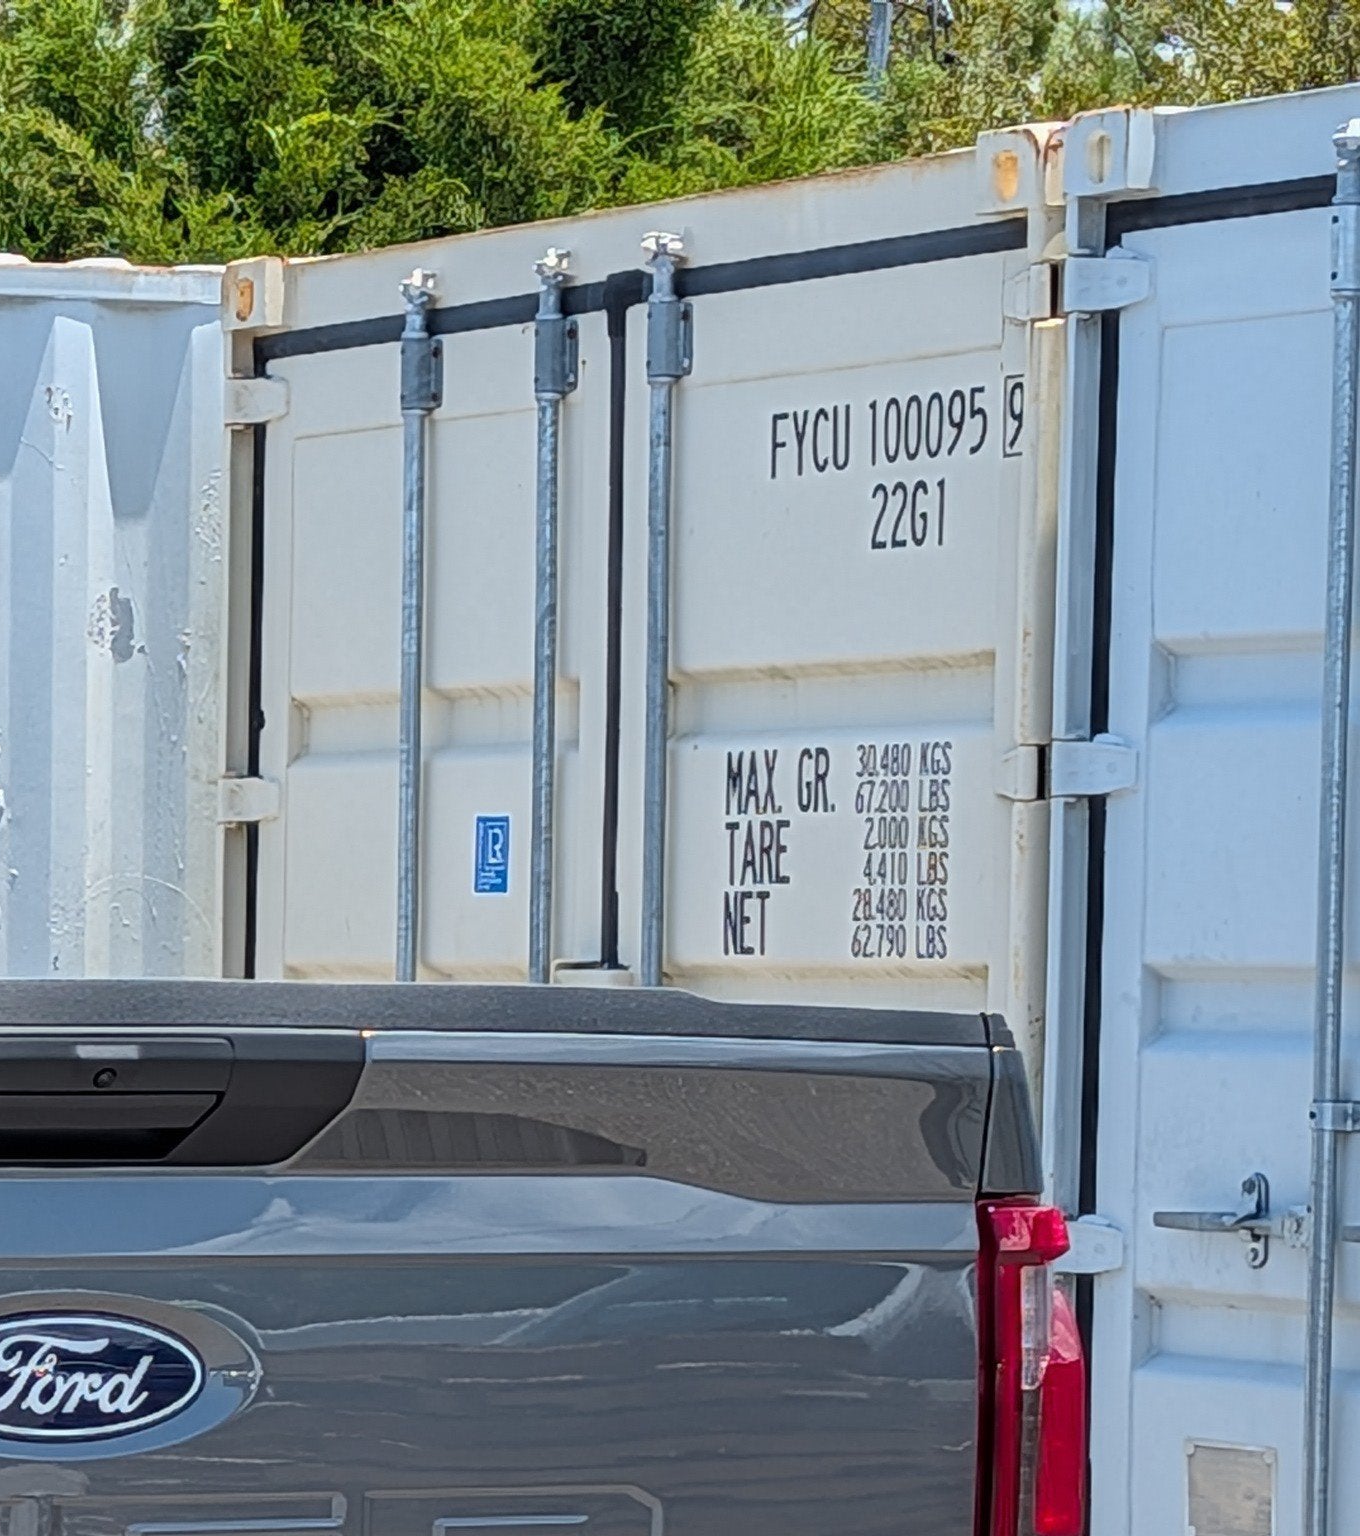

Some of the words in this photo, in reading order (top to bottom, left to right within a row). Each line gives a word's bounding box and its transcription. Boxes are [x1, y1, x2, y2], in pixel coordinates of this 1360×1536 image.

[770, 403, 851, 480] FYCU
[868, 385, 988, 467] 100095
[1008, 381, 1024, 450] 9
[870, 477, 946, 550] 22G1
[725, 749, 783, 816] MAX.
[797, 746, 837, 813] GR.
[919, 741, 953, 777] KGS
[918, 778, 952, 813] LBS
[725, 819, 791, 886] TARE
[917, 814, 951, 850] KGS
[916, 851, 950, 887] LBS
[723, 890, 771, 957] NET
[916, 887, 948, 922] KGS
[915, 923, 948, 960] LBS
